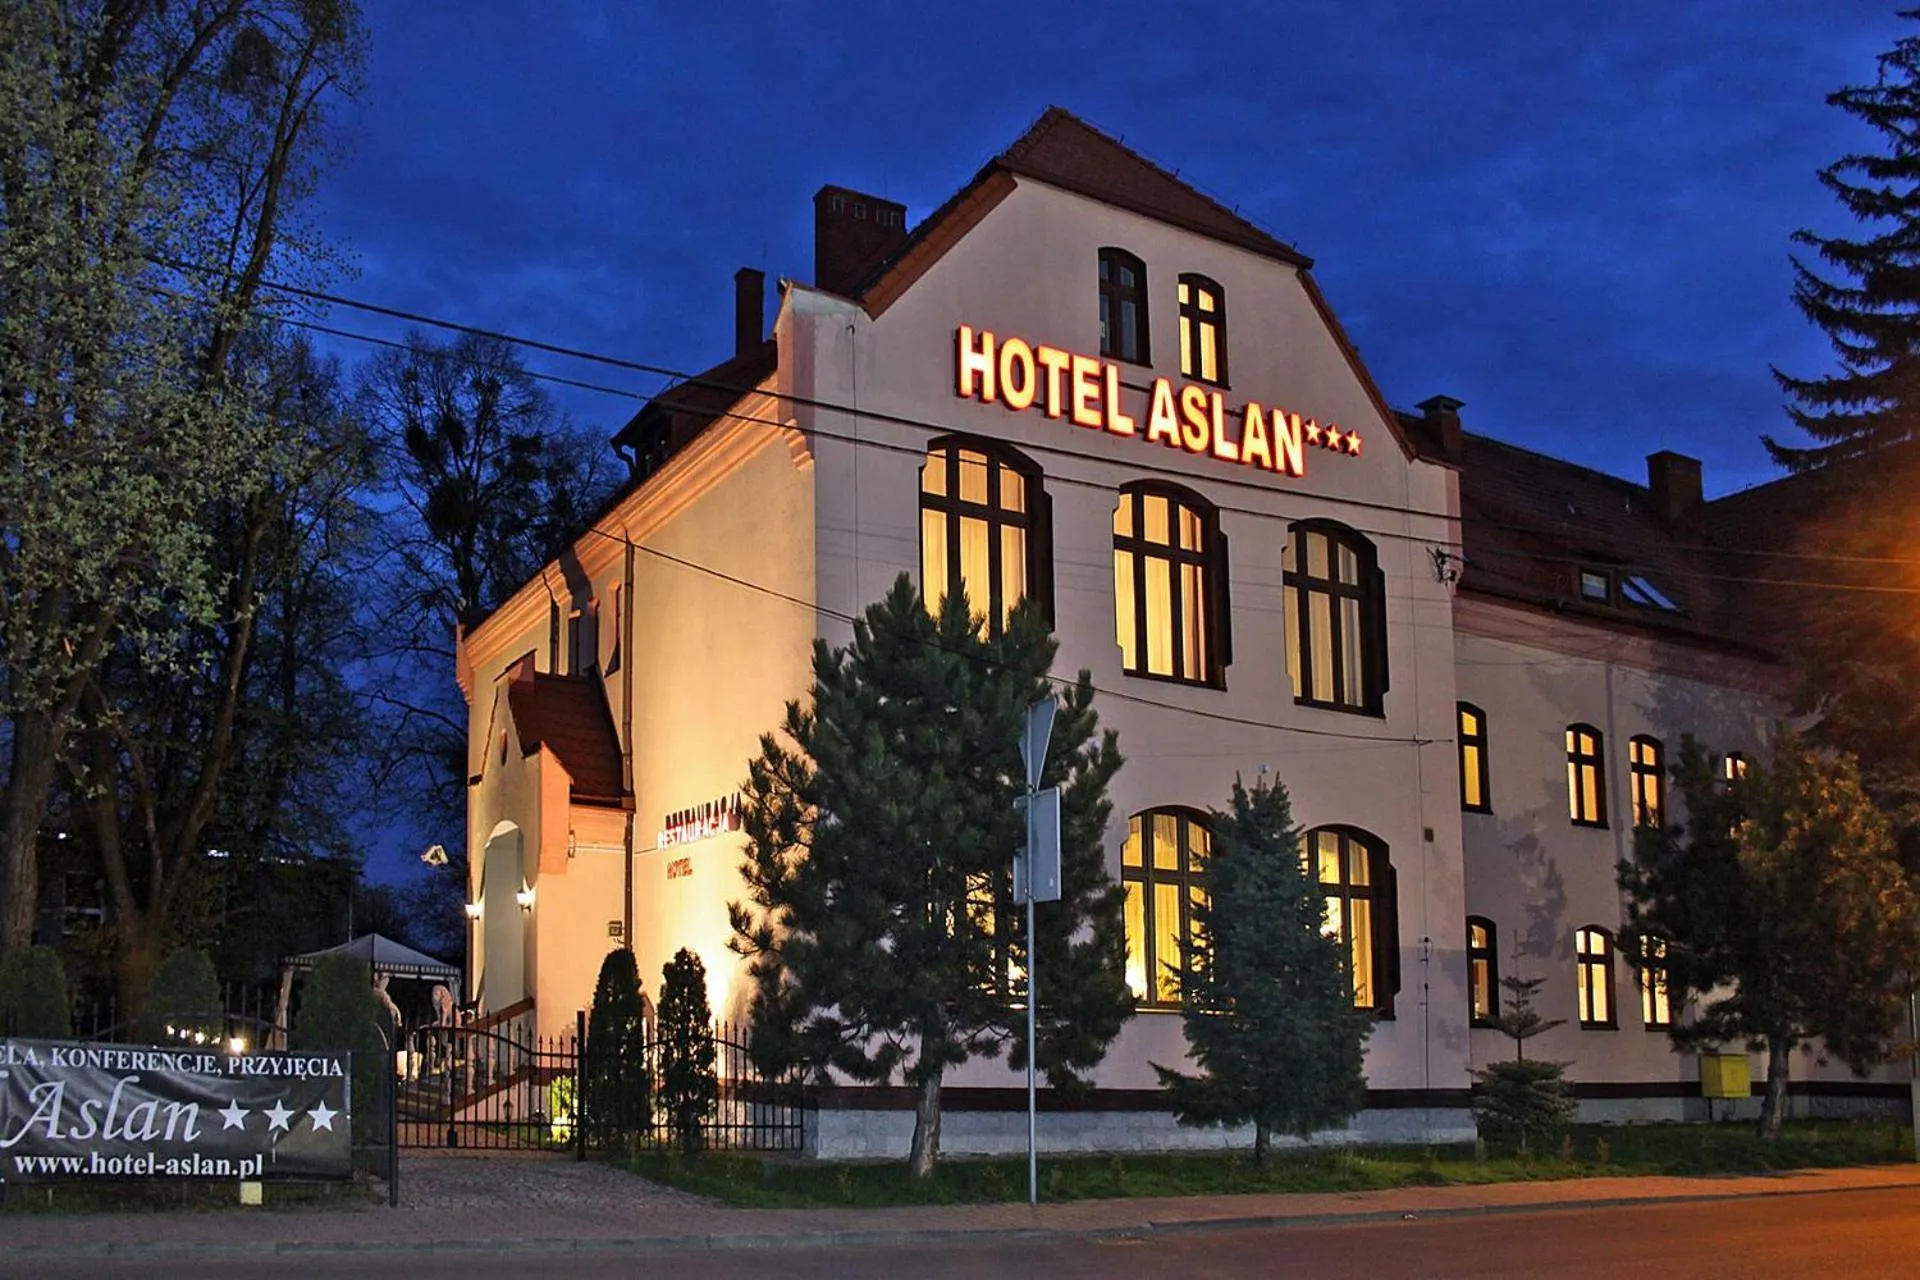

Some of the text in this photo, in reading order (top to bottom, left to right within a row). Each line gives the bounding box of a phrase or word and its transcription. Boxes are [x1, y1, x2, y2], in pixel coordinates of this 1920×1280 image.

[956, 324, 1305, 476] HOTEL ASLAN
[51, 1048, 223, 1077] KONFERENCJE,
[228, 1058, 344, 1081] PRZYJĘCIA
[0, 1075, 201, 1148] Aslan
[14, 1151, 263, 1179] www.hotel-aslan.pl
